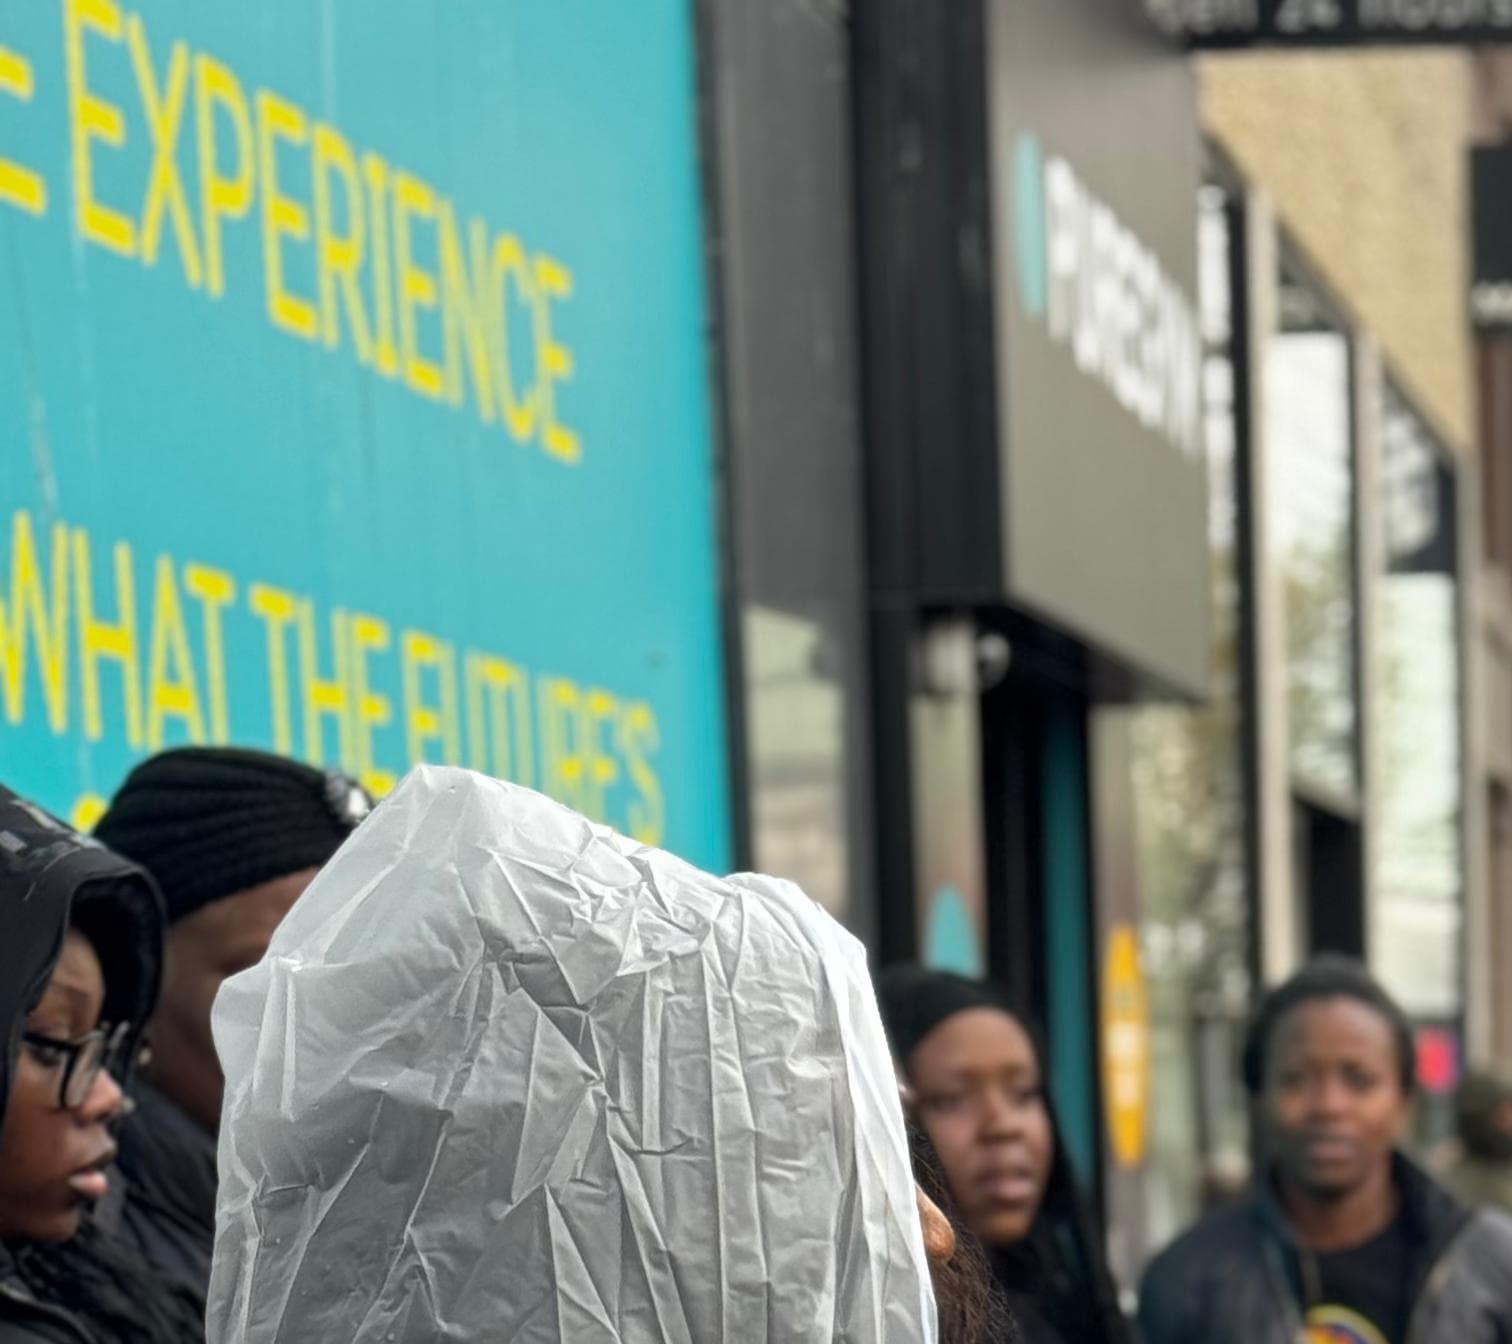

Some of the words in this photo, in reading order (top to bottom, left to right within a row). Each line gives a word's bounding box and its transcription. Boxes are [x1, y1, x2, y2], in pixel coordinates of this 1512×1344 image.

[64, 0, 583, 465] EXPERIENCE
[0, 509, 236, 755] WHAT
[248, 581, 399, 797] THE
